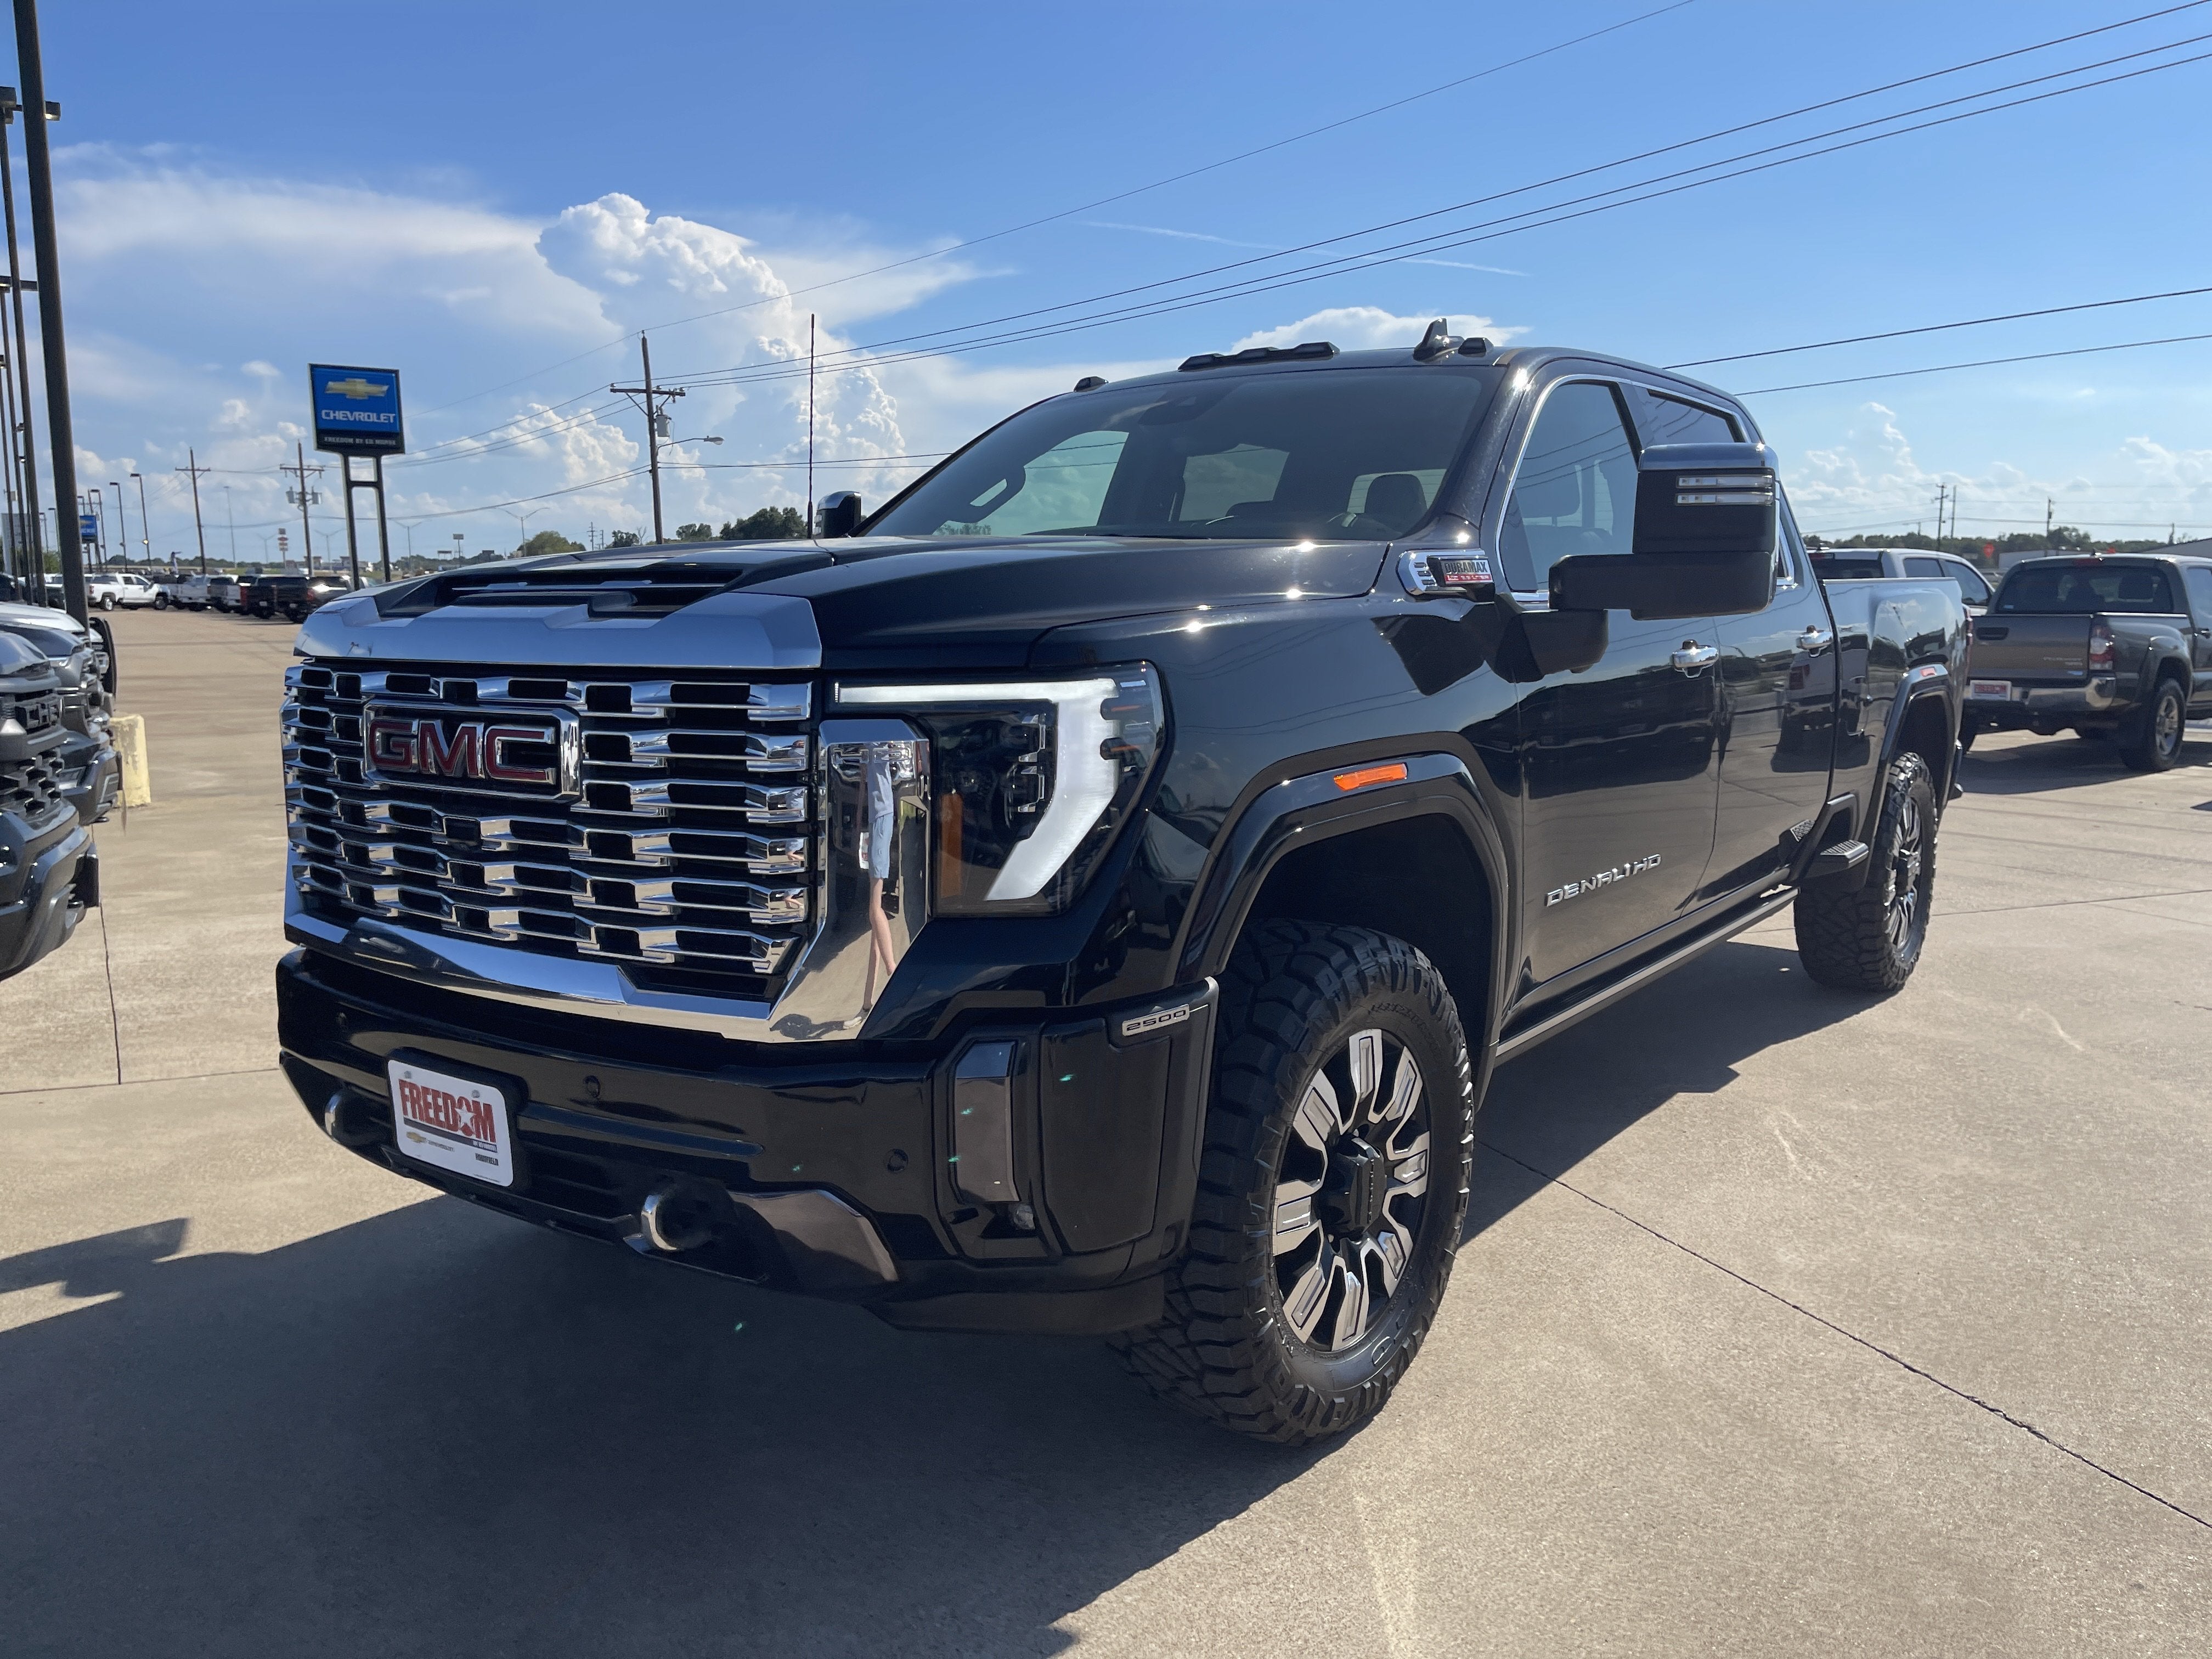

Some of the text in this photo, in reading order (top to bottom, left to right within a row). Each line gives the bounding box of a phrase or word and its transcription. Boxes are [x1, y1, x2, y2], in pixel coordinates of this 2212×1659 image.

[321, 410, 396, 423] CHEVROLET
[1444, 561, 1488, 573] DURAMAX
[369, 718, 556, 785] GMC
[1126, 1010, 1186, 1031] 2500
[398, 1079, 496, 1143] FREEDOM
